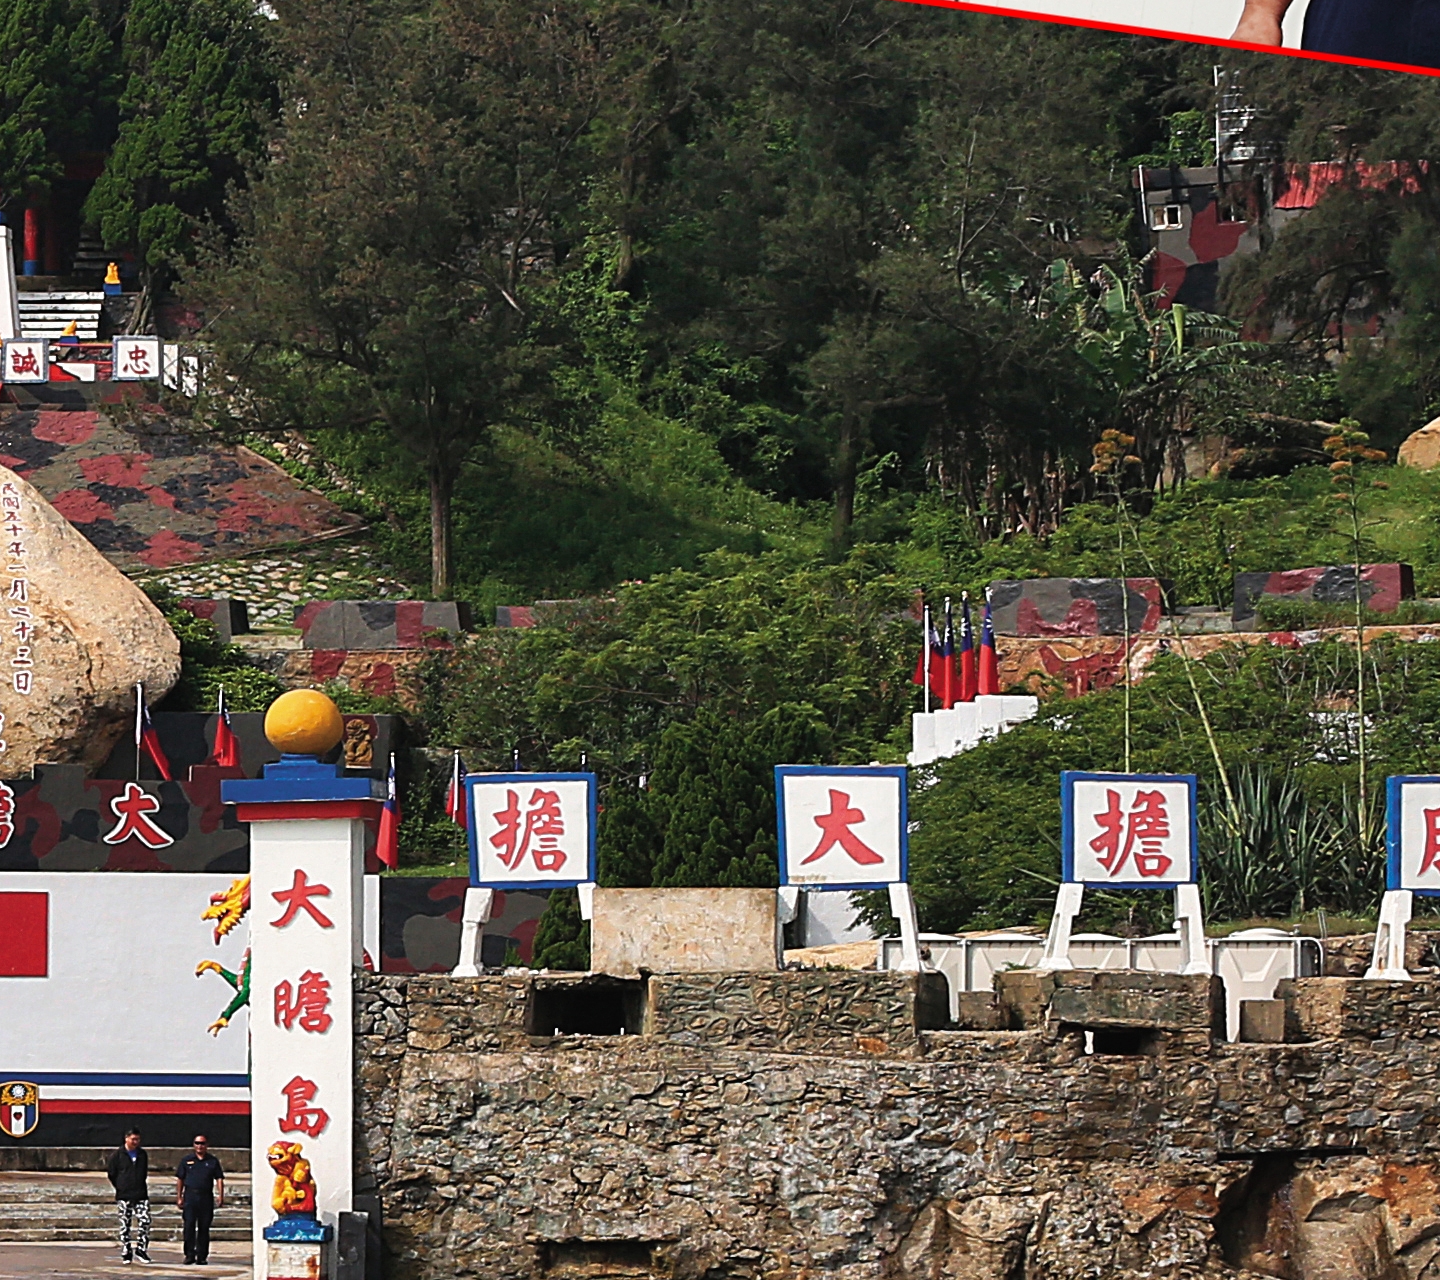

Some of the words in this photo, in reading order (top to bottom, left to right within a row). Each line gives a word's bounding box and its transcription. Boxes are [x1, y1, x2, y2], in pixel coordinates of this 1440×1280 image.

[11, 347, 40, 377] 誠
[123, 344, 152, 375] 忠
[2, 483, 31, 692] 民國五十年一月二十三日
[488, 787, 568, 872] 擔
[801, 789, 885, 866] 大
[1089, 788, 1173, 878] 擔
[269, 867, 335, 1139] 大膽島
